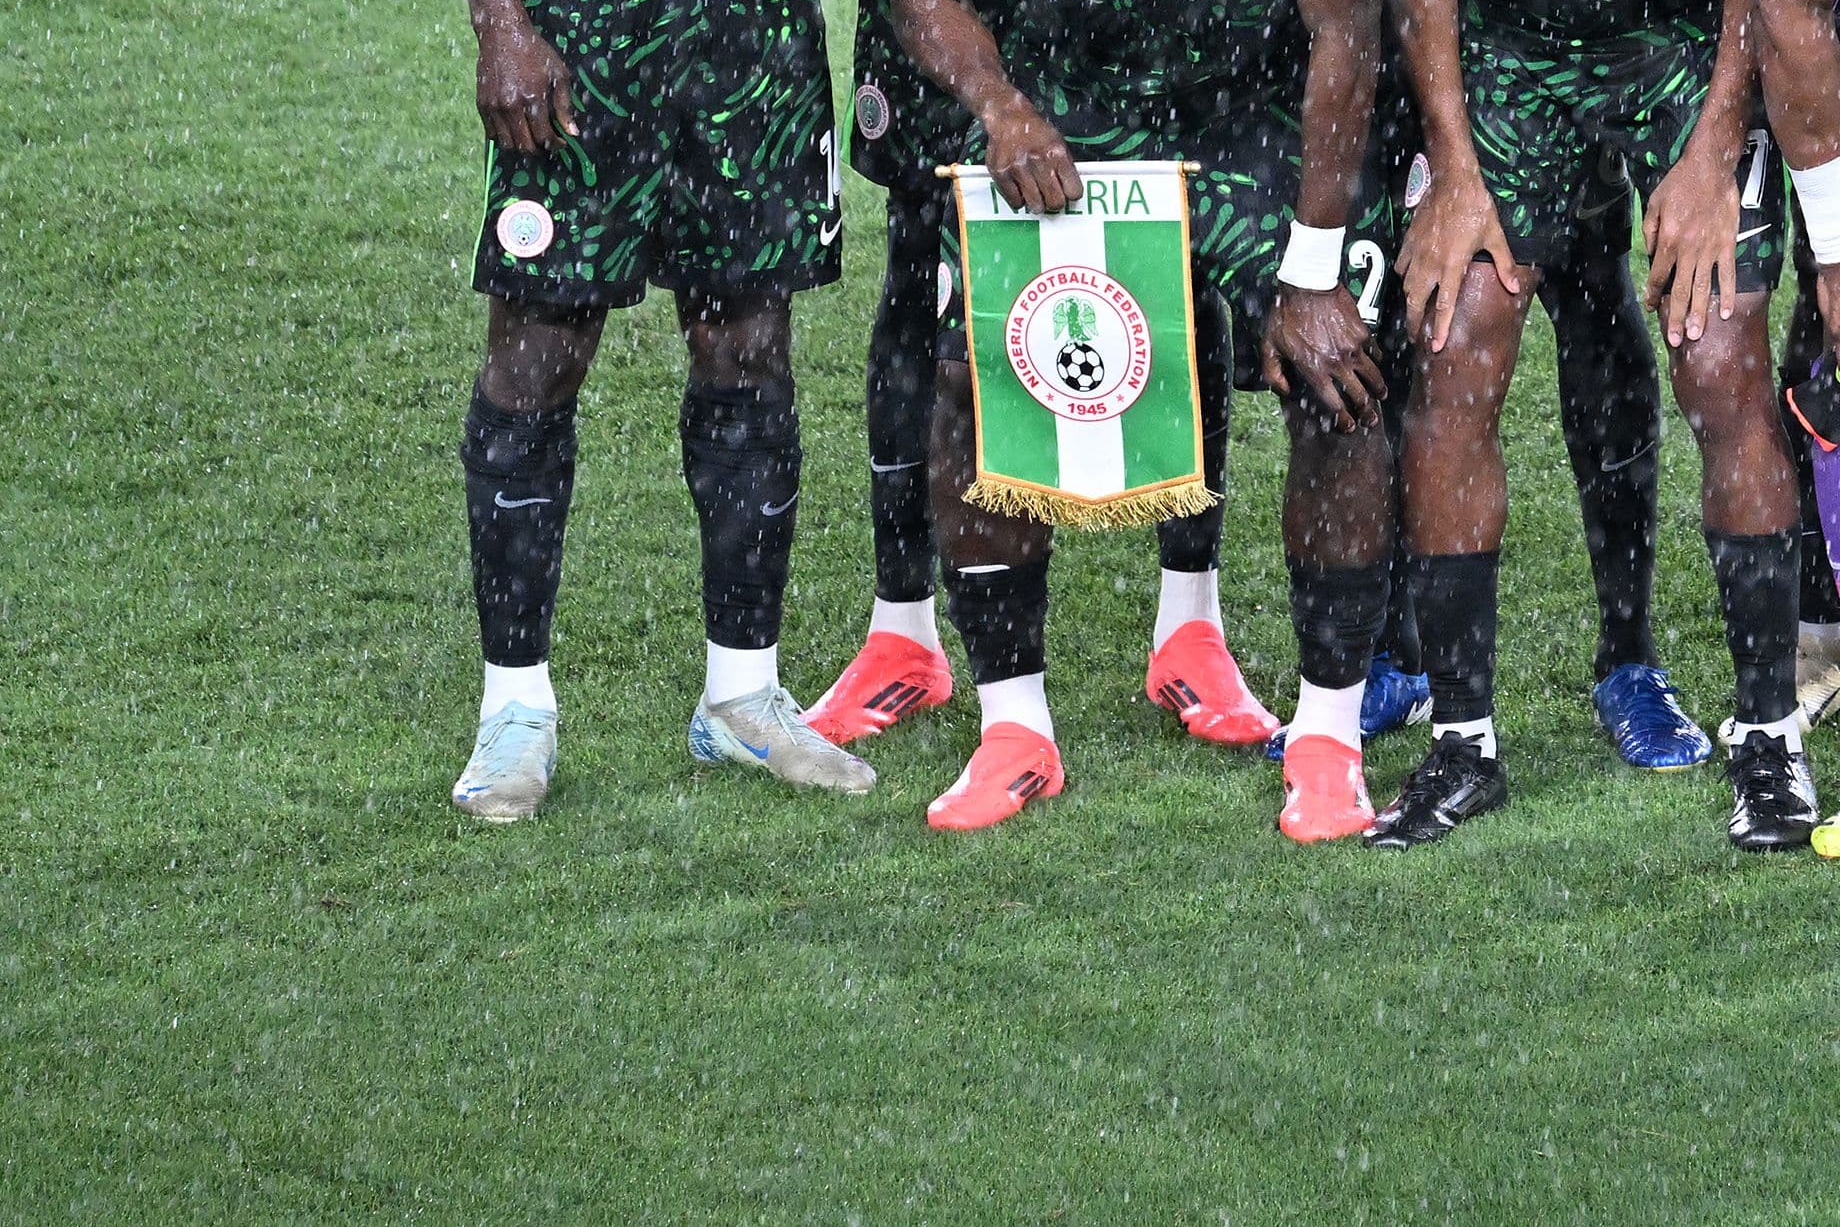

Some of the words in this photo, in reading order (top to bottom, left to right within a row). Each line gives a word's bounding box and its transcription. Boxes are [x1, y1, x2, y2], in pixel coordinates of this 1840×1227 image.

[1020, 272, 1098, 311] FOOTBALL
[1349, 239, 1385, 325] 2
[1011, 316, 1039, 388] NIGERIA
[1104, 283, 1146, 390] FEDERATION
[1068, 403, 1107, 415] 1945
